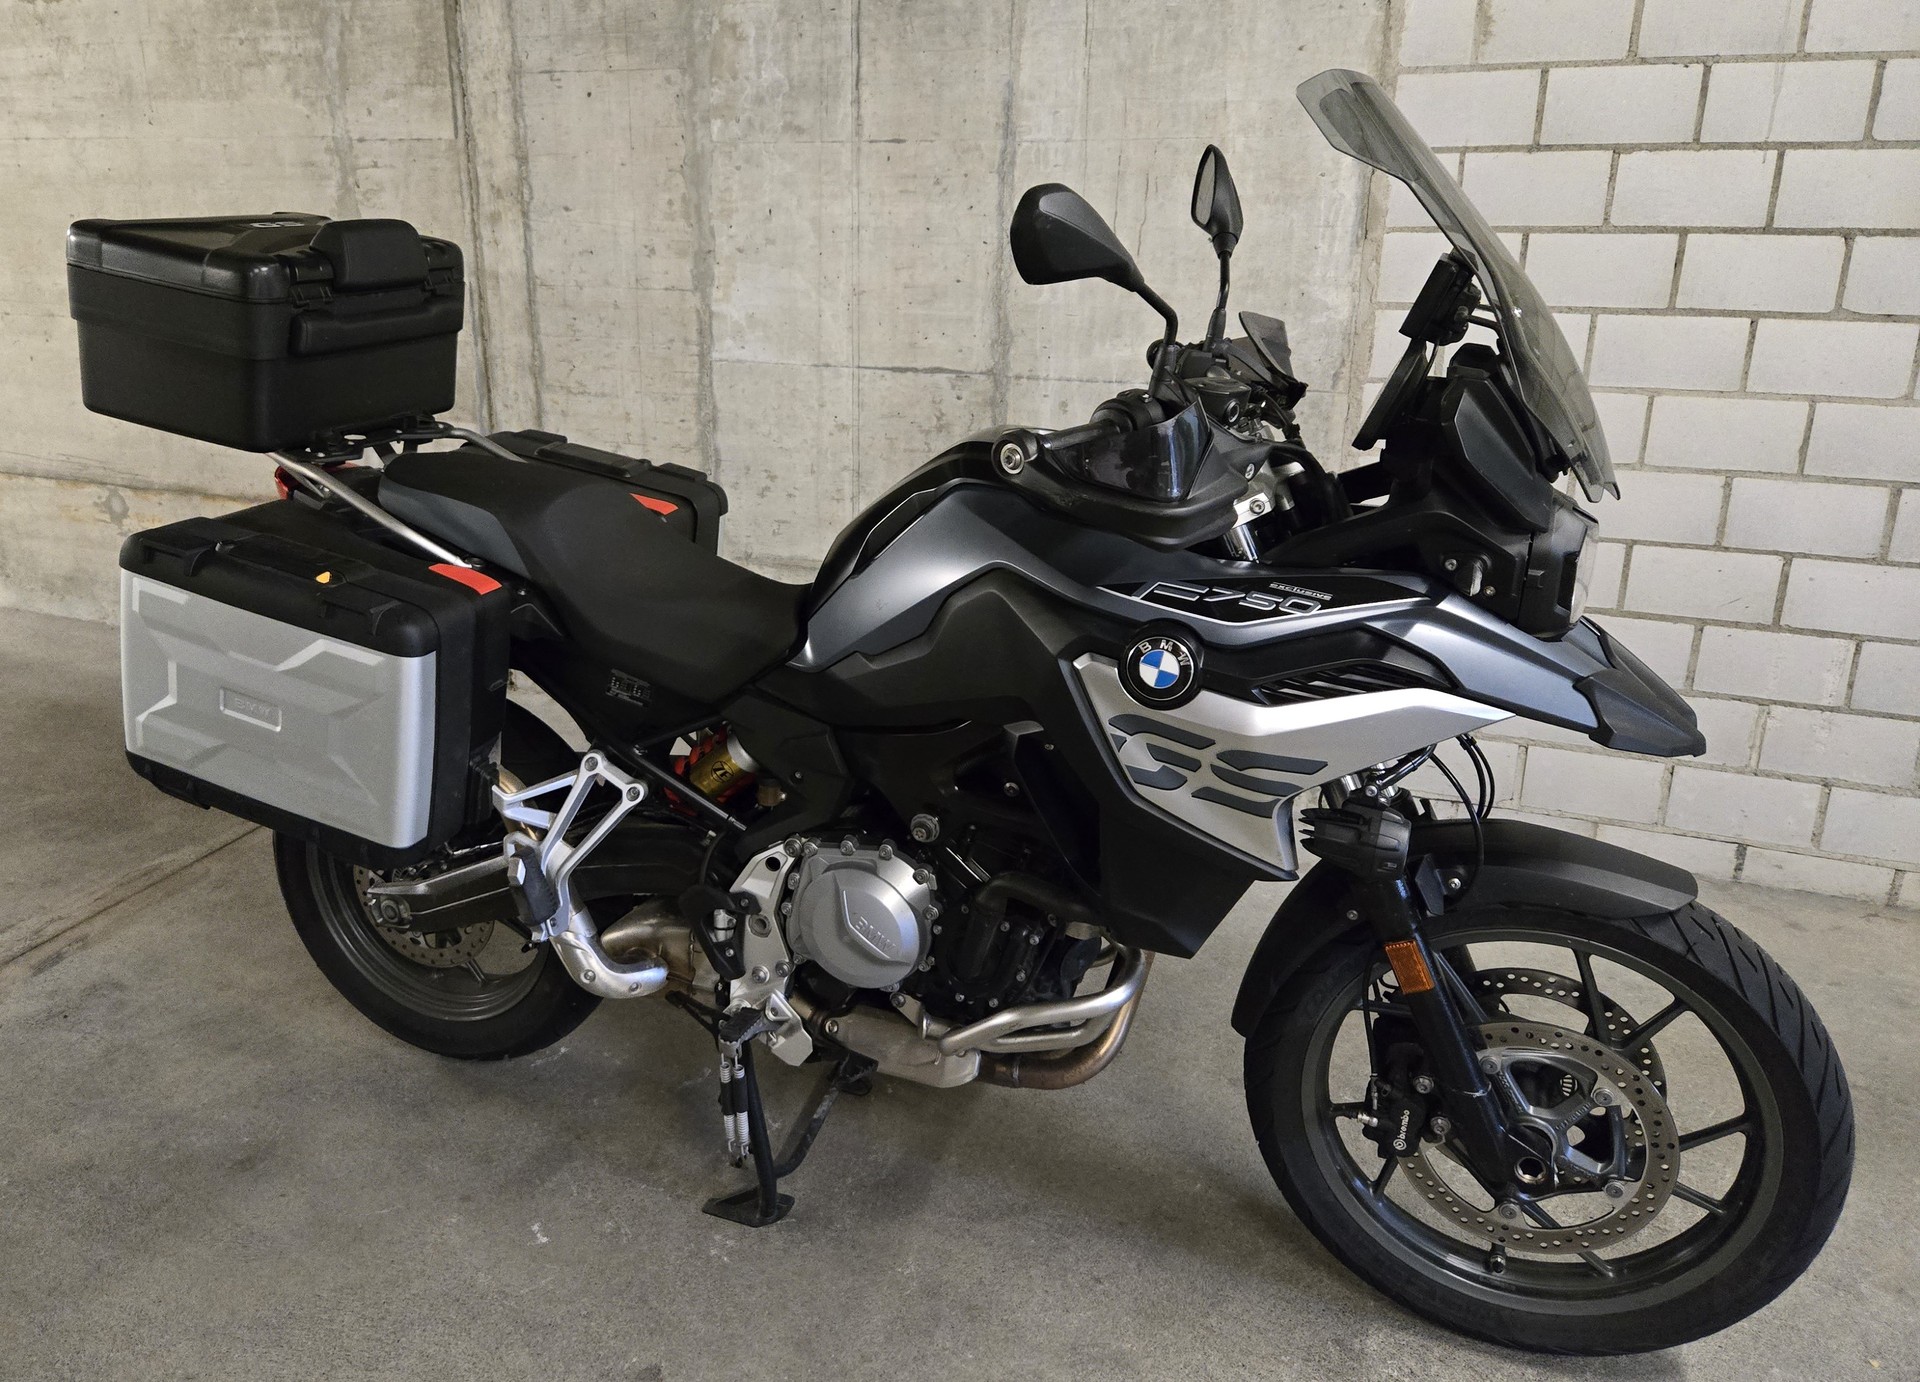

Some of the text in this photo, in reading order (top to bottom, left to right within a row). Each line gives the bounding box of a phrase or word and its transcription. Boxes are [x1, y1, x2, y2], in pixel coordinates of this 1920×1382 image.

[1269, 582, 1333, 601] exclusive
[1138, 639, 1192, 667] BMW
[1397, 1109, 1410, 1140] brembo
